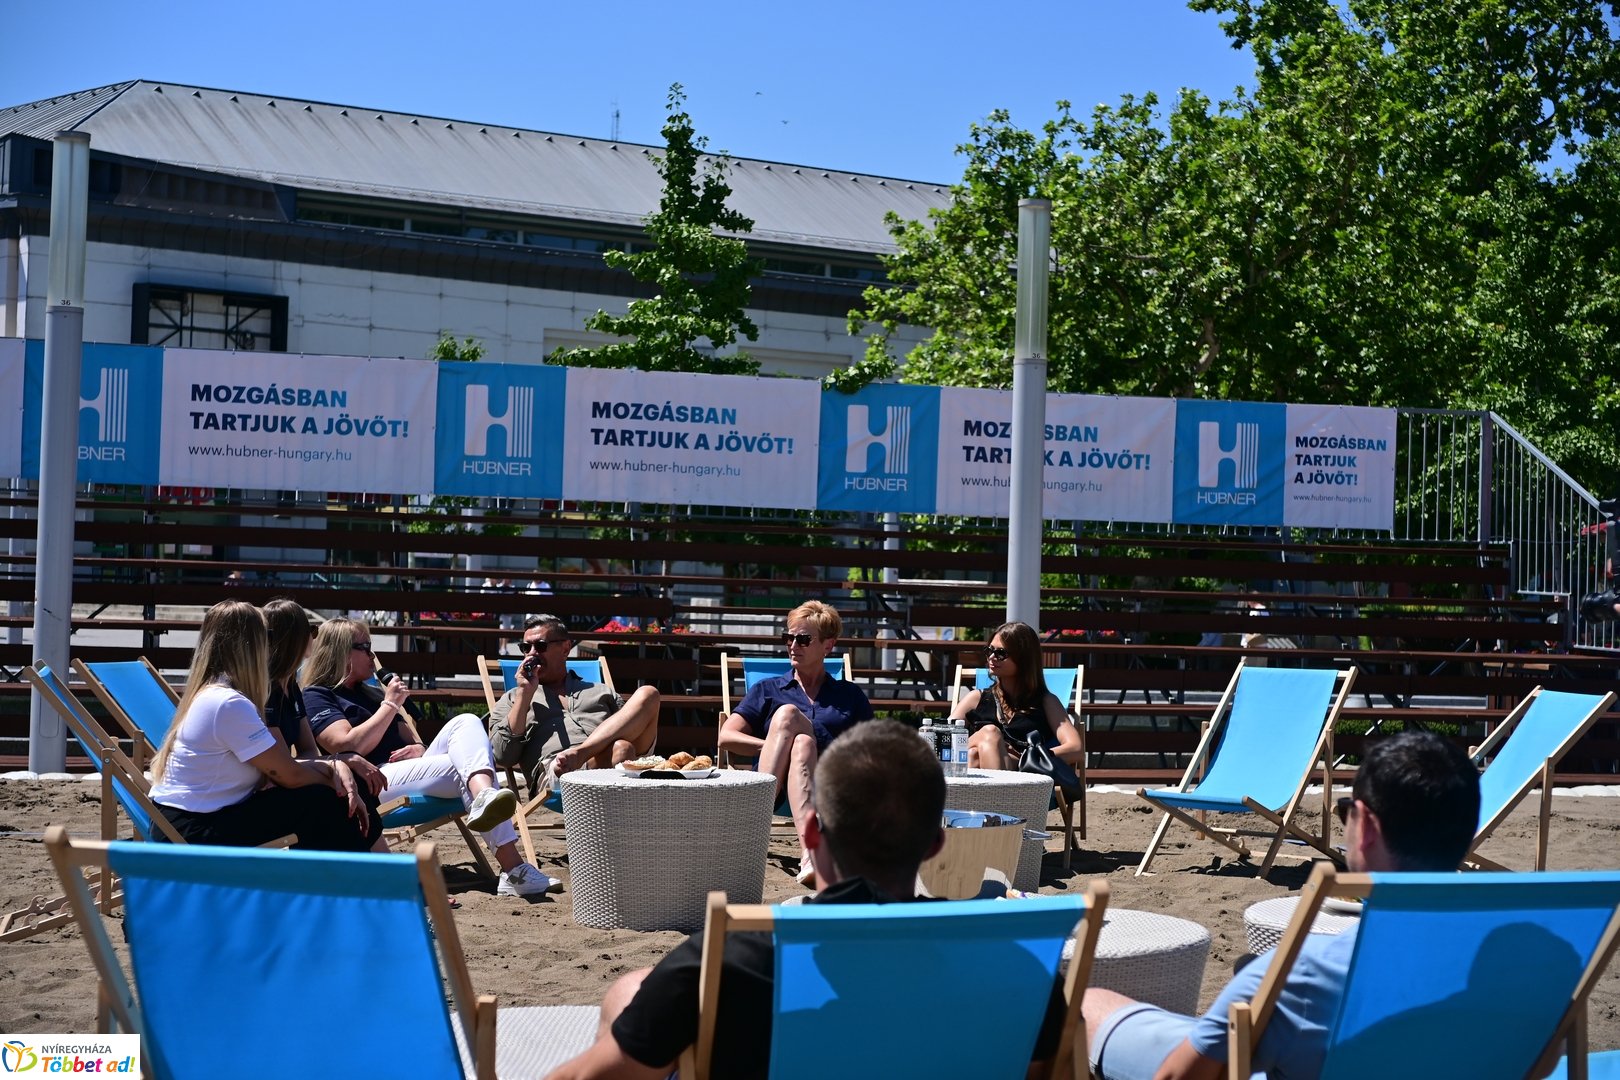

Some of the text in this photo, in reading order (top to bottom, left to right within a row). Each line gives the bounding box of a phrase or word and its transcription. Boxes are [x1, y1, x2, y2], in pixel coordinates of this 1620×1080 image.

[190, 383, 347, 408] MOZGÁSBAN
[591, 401, 737, 426] MOZGÁSBAN
[189, 411, 409, 439] TARTJUK A JÖVŐT!
[963, 420, 1099, 443] MOZSBAN
[590, 428, 794, 455] TARTJUK A JÖVŐT!
[1295, 434, 1387, 451] MOZGÁSBAN
[77, 445, 126, 461] BNER
[188, 443, 353, 463] www.hubner-hungary.hu
[962, 445, 1151, 471] TARTK A JÖVŐT!
[1295, 454, 1357, 467] TARTJUK
[463, 460, 532, 477] HÜBNER
[589, 459, 741, 477] www.hubner-hungary.hu
[844, 476, 908, 492] HÜBNER
[1294, 472, 1304, 484] A
[1197, 491, 1256, 505] HÜBNER
[1293, 494, 1372, 503] www.hubner-hungary.hu
